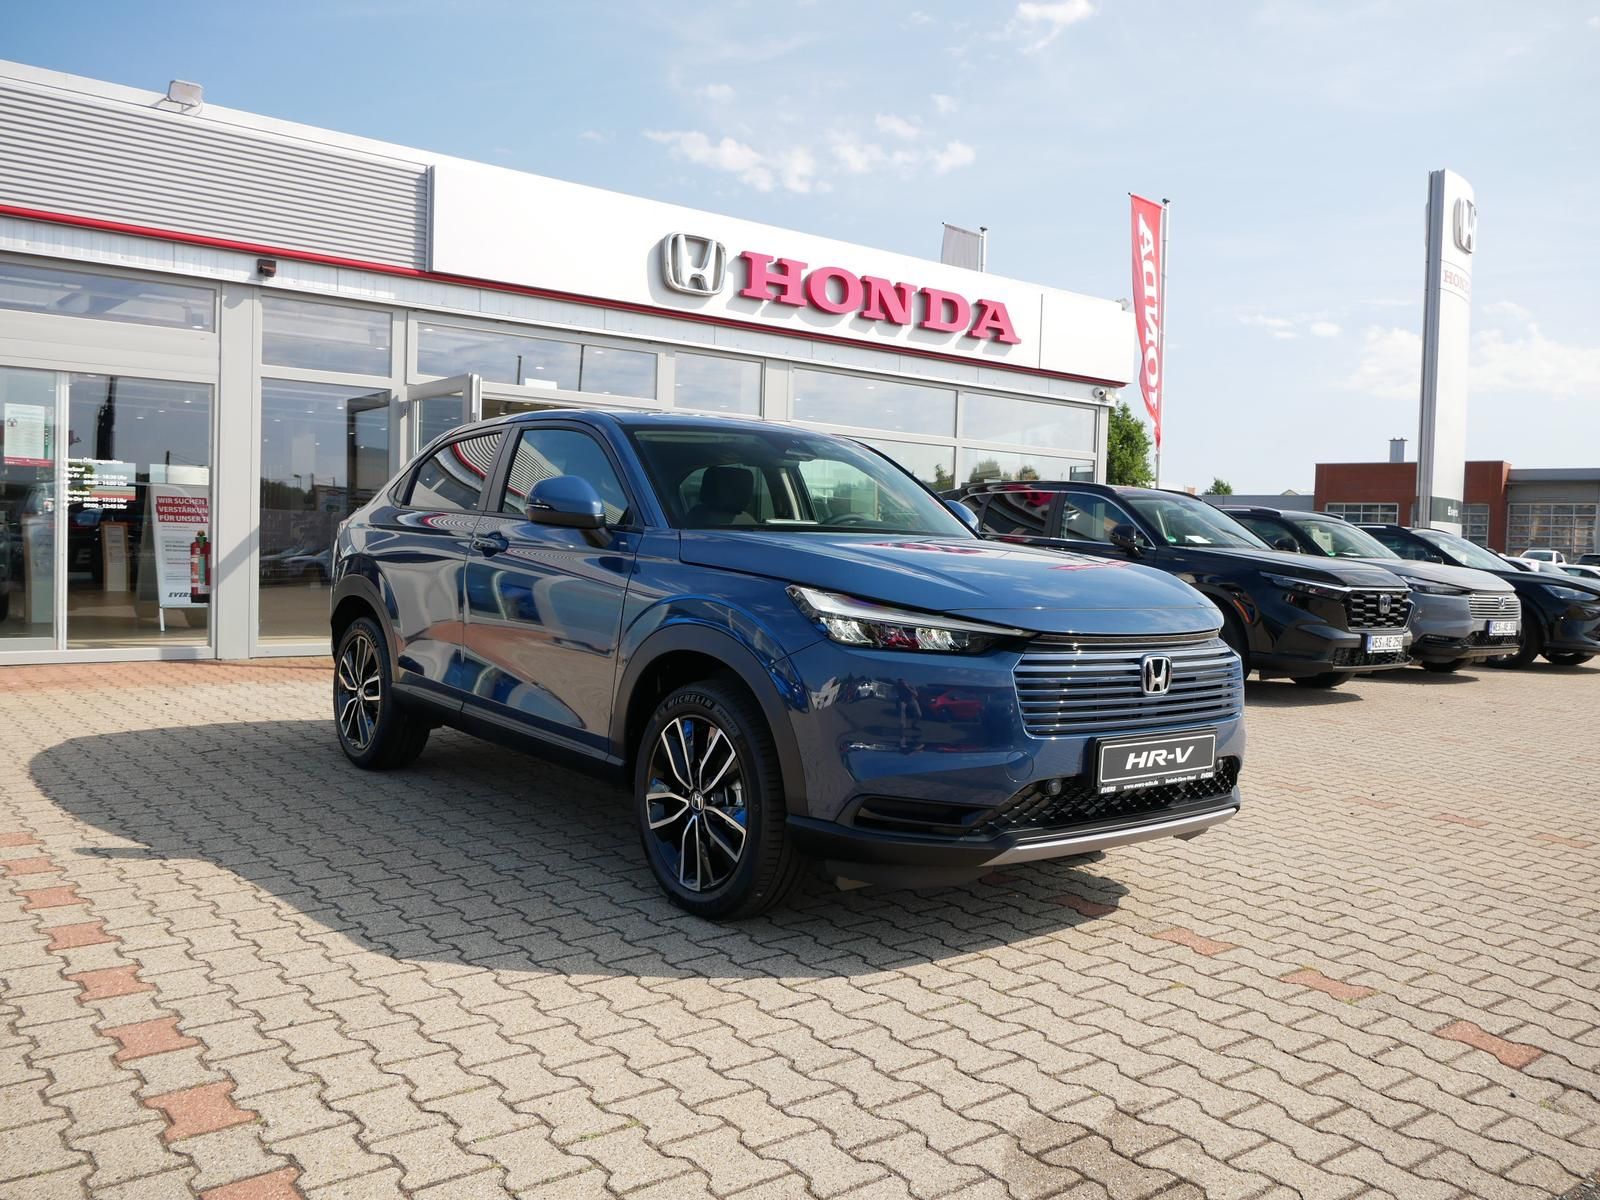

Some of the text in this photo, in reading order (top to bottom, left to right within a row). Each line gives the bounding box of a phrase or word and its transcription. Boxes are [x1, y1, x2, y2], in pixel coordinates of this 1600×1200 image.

[740, 250, 1022, 346] HONDA
[667, 694, 713, 710] MICHELIN
[1125, 745, 1195, 770] HR-V
